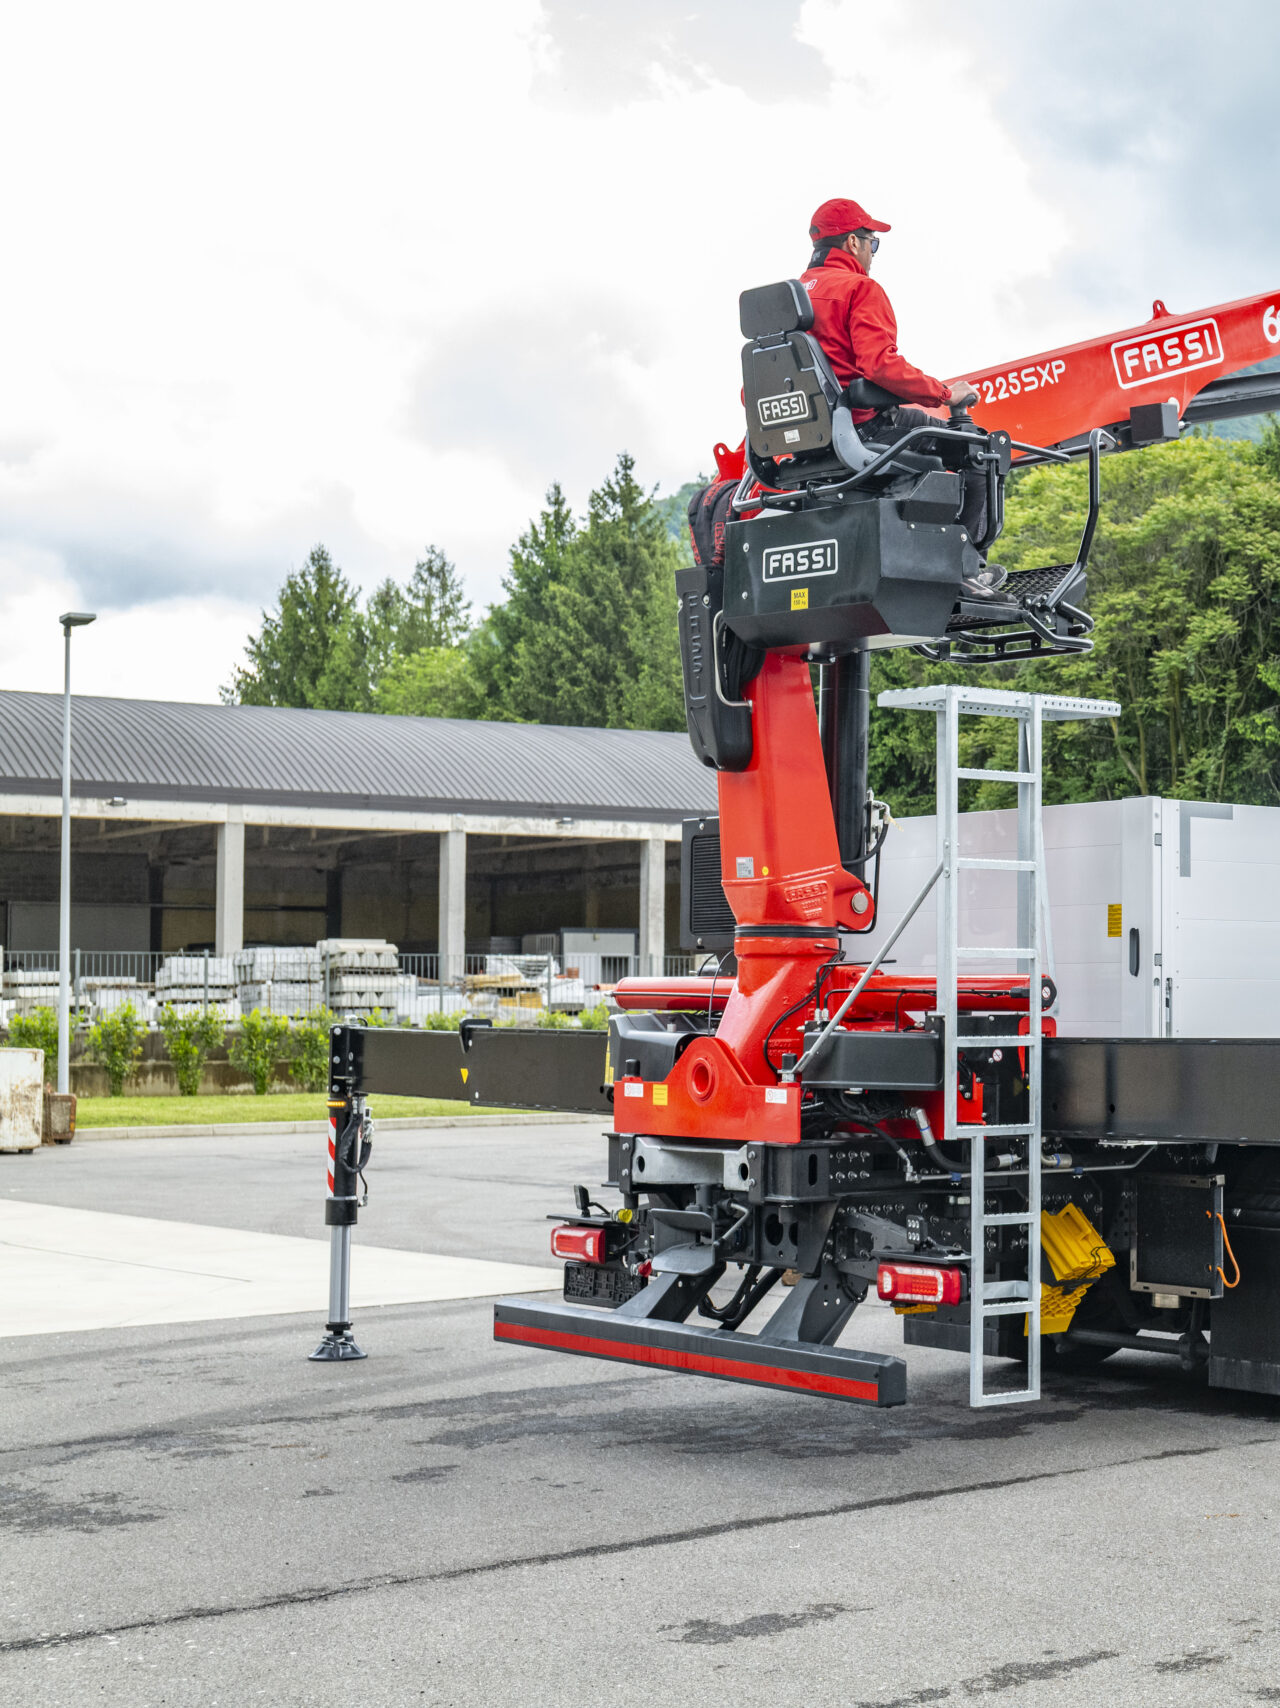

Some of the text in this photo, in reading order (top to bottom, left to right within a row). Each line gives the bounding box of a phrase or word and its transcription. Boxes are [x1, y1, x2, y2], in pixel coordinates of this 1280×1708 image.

[1122, 328, 1215, 378] FASSI
[970, 359, 1066, 404] 225SXP
[761, 395, 804, 420] FASSI
[769, 546, 831, 576] FASSI
[687, 594, 704, 690] FASSI
